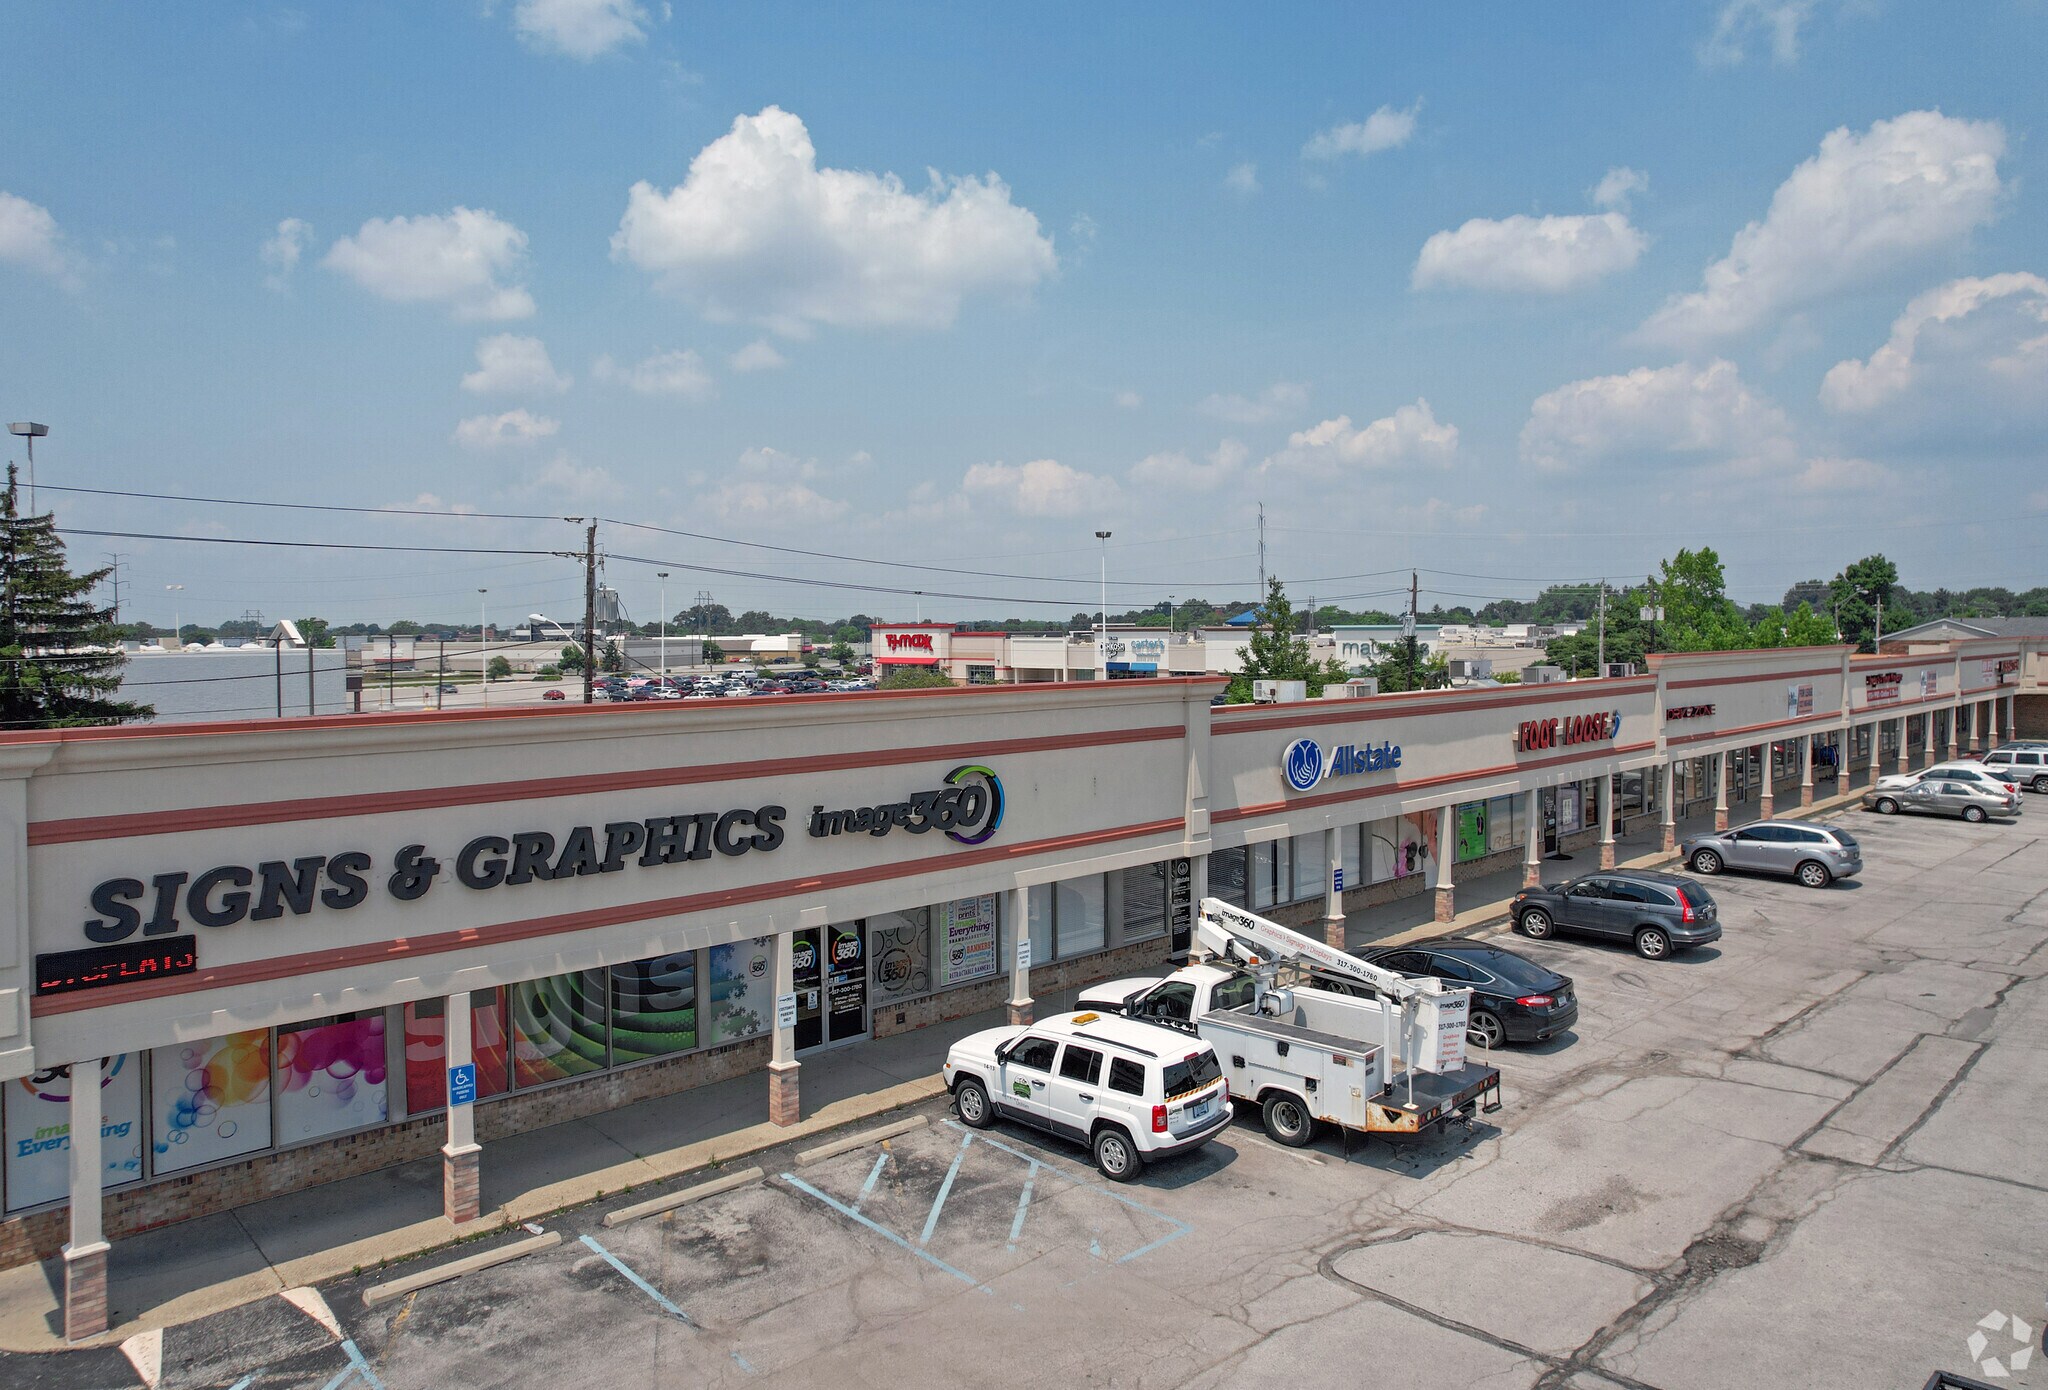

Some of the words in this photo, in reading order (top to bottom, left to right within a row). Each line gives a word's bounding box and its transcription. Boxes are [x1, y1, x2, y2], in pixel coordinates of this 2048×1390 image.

[1518, 717, 1558, 752] FOOT
[1563, 711, 1609, 745] LOOSE
[1325, 741, 1401, 778] Allstate
[809, 784, 988, 838] image360
[85, 850, 371, 943] SIGNS
[388, 844, 440, 901] &
[456, 805, 787, 890] GRAPHICS
[957, 910, 977, 920] prints
[1221, 908, 1255, 930] image360
[949, 923, 990, 937] Everything
[1260, 924, 1283, 940] Graphics
[1285, 935, 1307, 950] Signage
[836, 946, 858, 960] 360
[838, 940, 858, 950] image
[882, 966, 907, 982] 360
[1336, 958, 1378, 982] 317-300-1780
[17, 1120, 132, 1158] Everying
